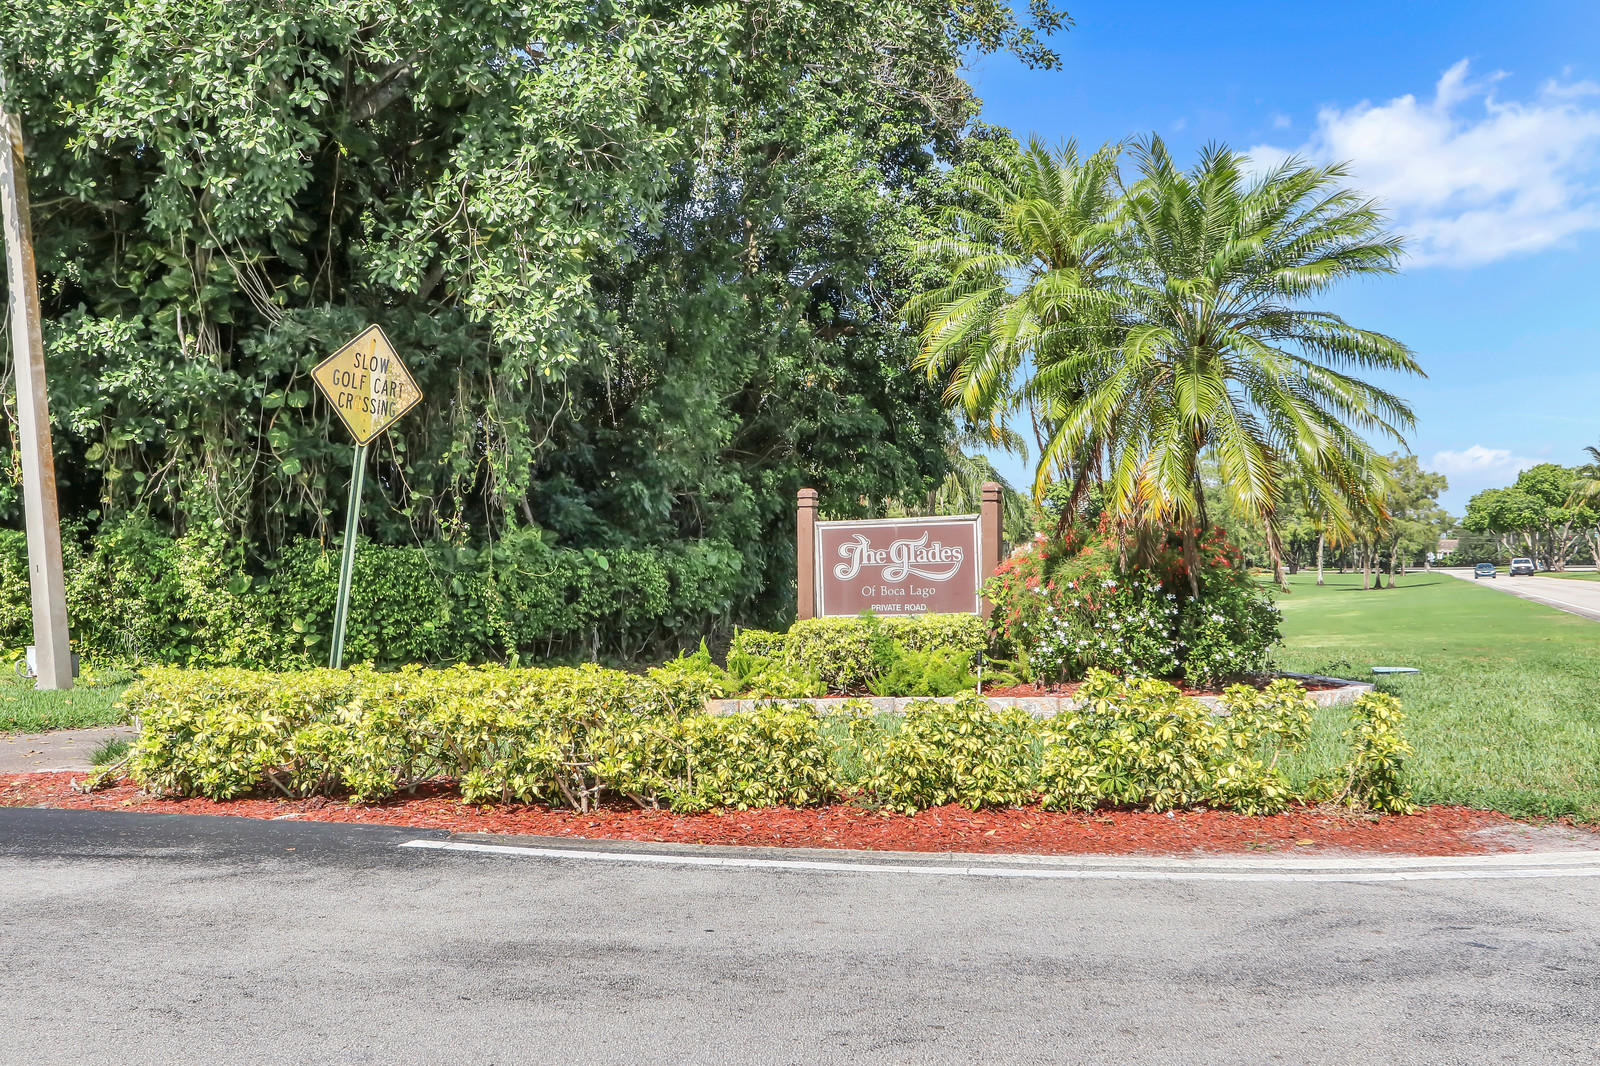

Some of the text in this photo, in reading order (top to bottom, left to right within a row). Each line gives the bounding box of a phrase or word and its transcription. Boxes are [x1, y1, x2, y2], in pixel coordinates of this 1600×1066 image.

[354, 352, 390, 374] SLOW
[333, 369, 404, 398] GOLF CART
[833, 530, 964, 583] The Glades
[861, 585, 936, 598] Of Boca Lago
[871, 603, 927, 611] PRIVATE ROAD
